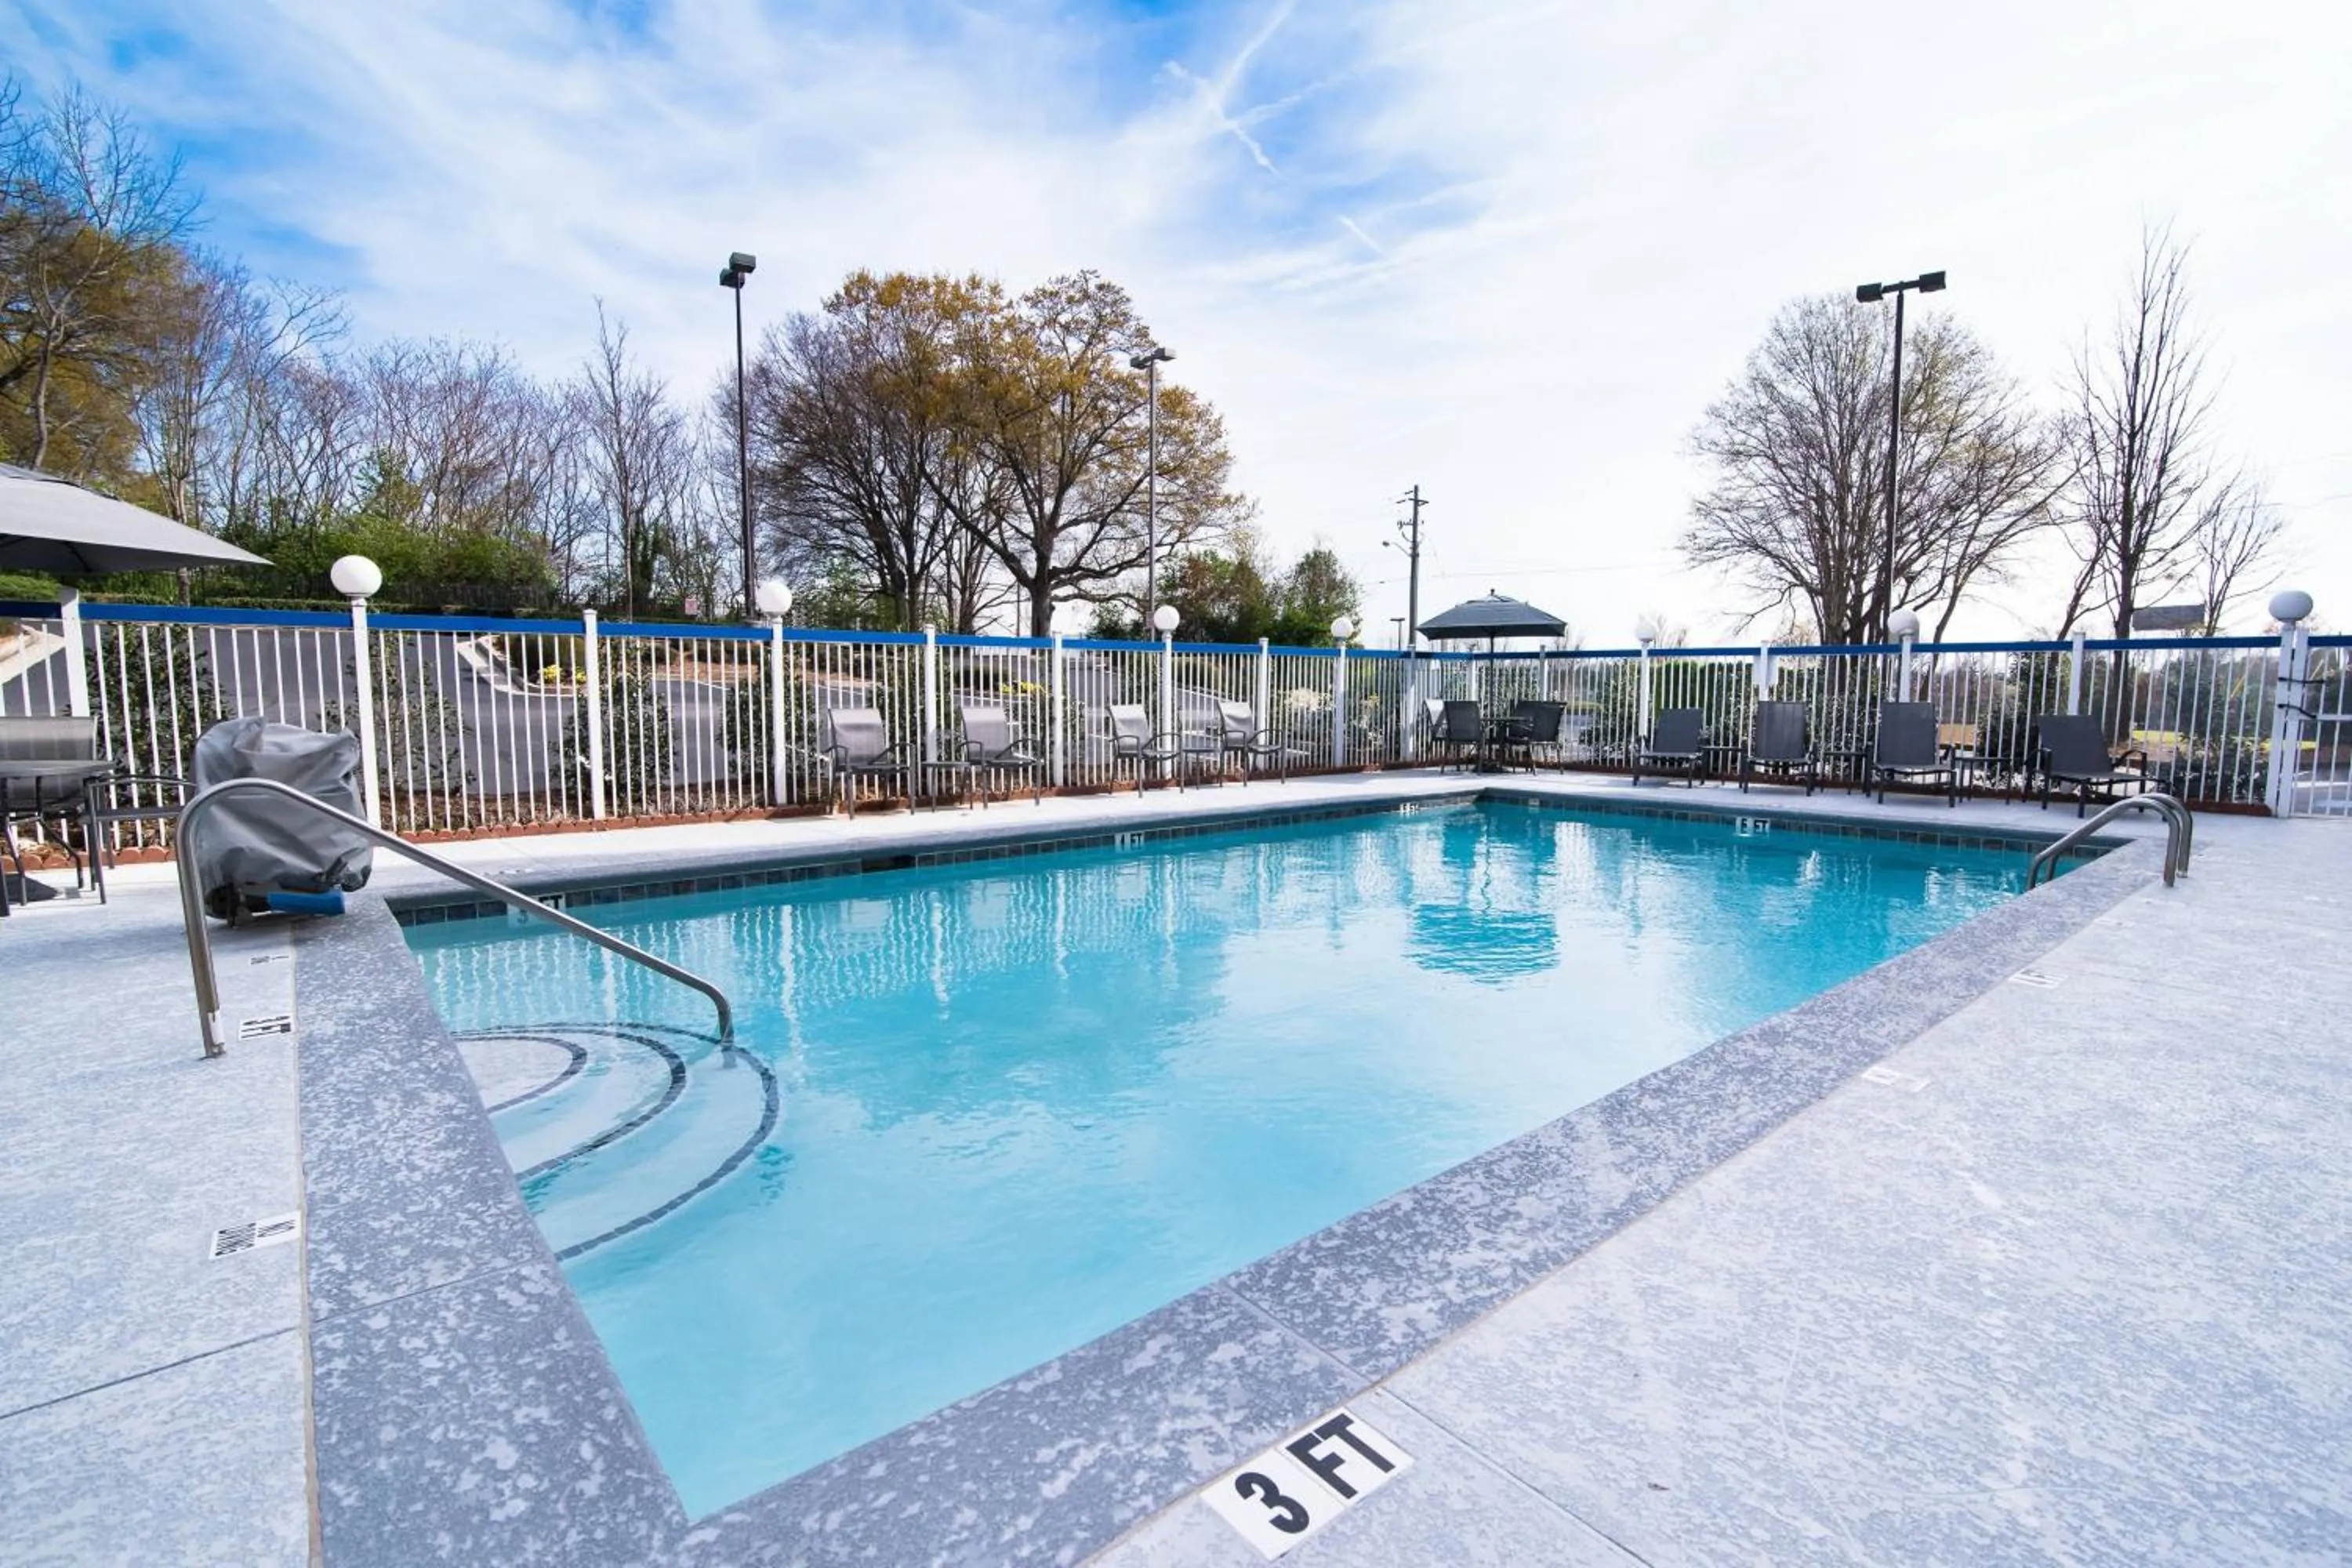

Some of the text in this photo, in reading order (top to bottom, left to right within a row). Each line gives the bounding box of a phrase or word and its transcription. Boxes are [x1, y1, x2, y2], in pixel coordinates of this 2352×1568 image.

[1131, 833, 1142, 850] FT
[1235, 1413, 1396, 1534] 3 FT
